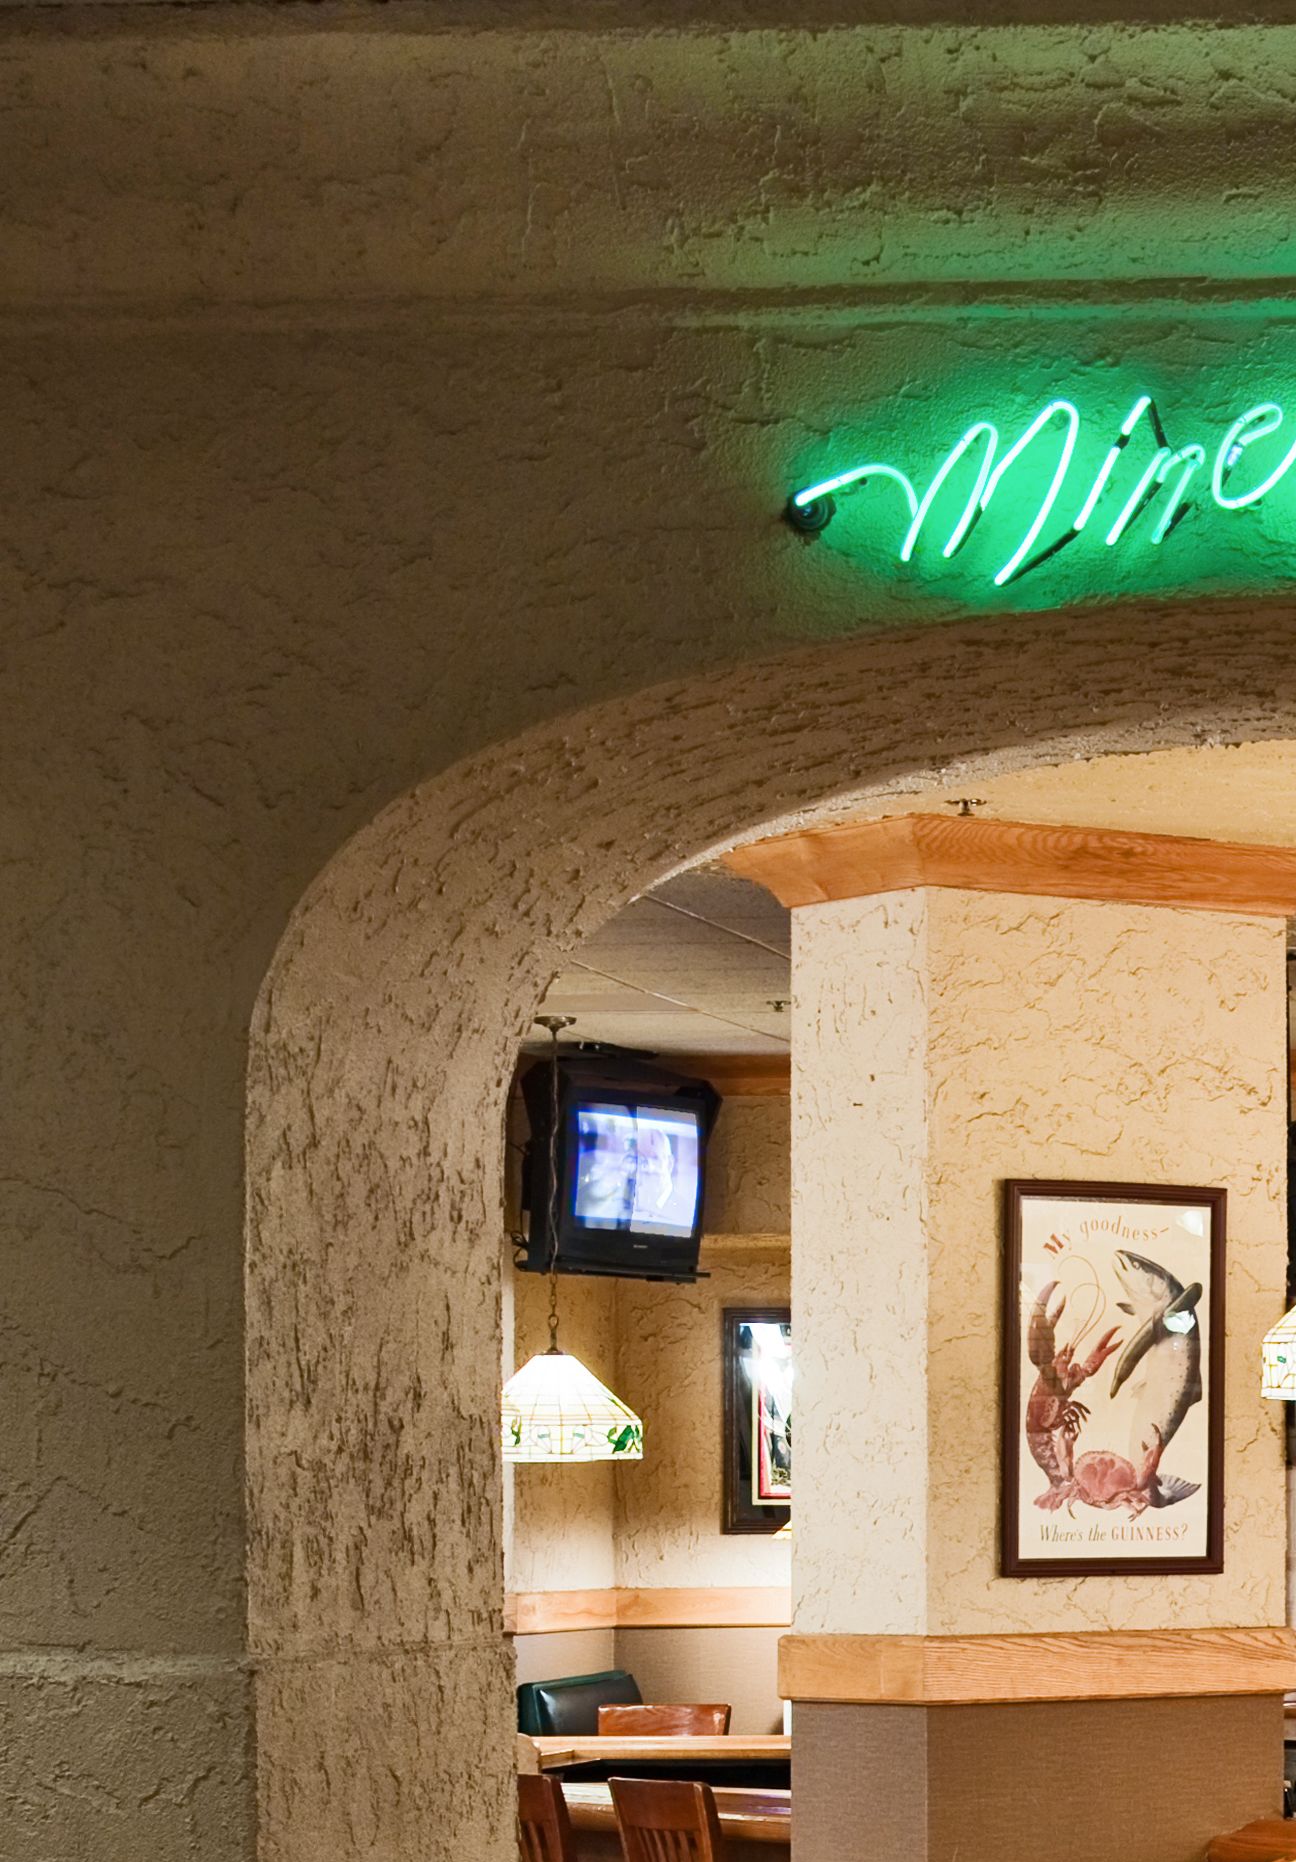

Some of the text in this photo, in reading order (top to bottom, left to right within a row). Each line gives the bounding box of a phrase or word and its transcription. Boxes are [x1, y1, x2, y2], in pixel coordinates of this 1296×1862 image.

[1043, 1229, 1072, 1260] My
[1040, 1524, 1083, 1542] Where's
[1088, 1523, 1107, 1541] the
